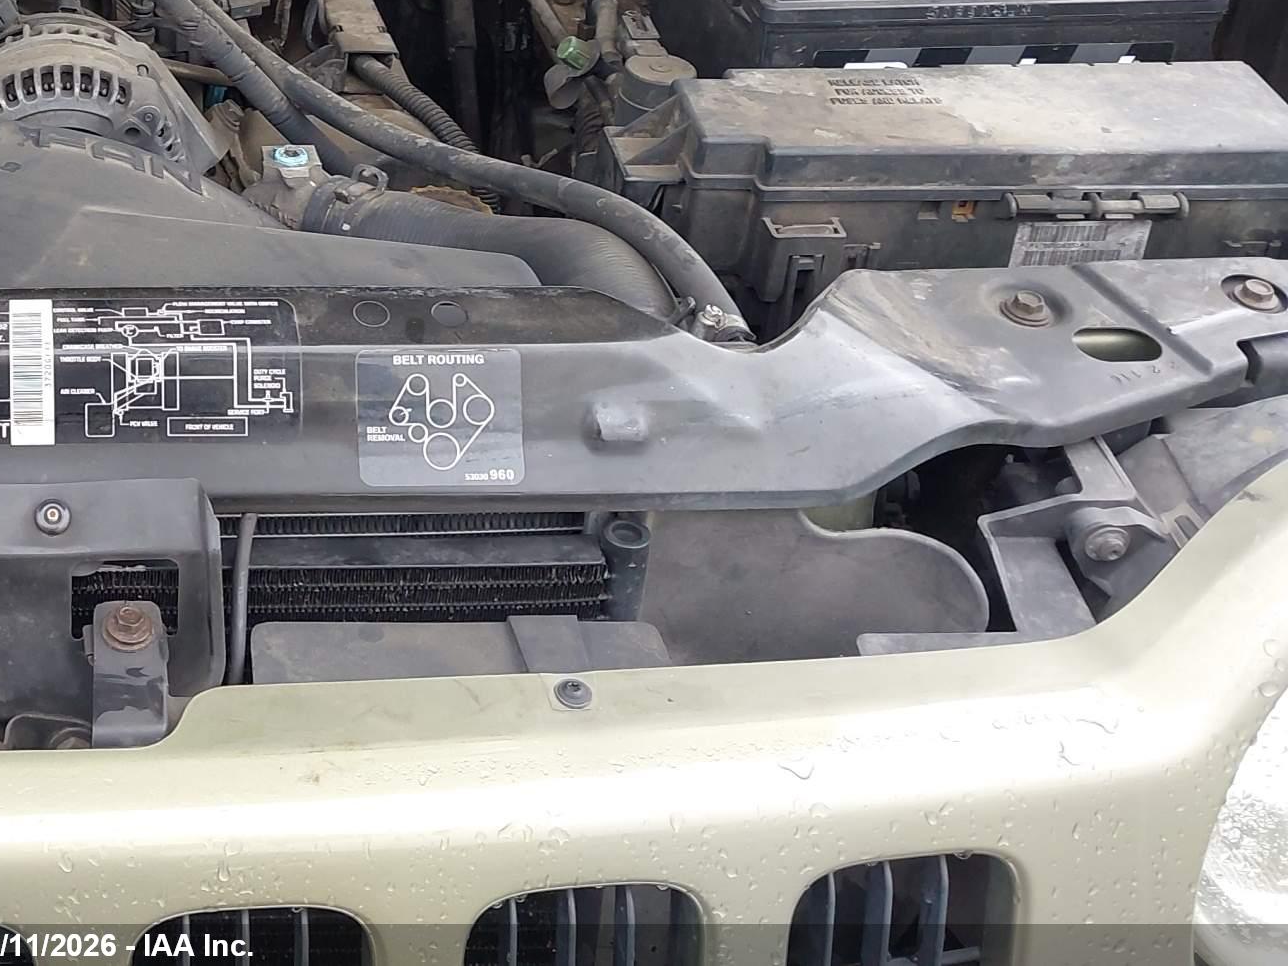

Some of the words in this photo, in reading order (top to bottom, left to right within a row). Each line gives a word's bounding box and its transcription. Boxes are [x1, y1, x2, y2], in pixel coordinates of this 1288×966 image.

[37, 129, 204, 196] FAN
[392, 355, 424, 365] BELT
[428, 354, 485, 364] ROUTING
[367, 434, 406, 442] REMOVAL
